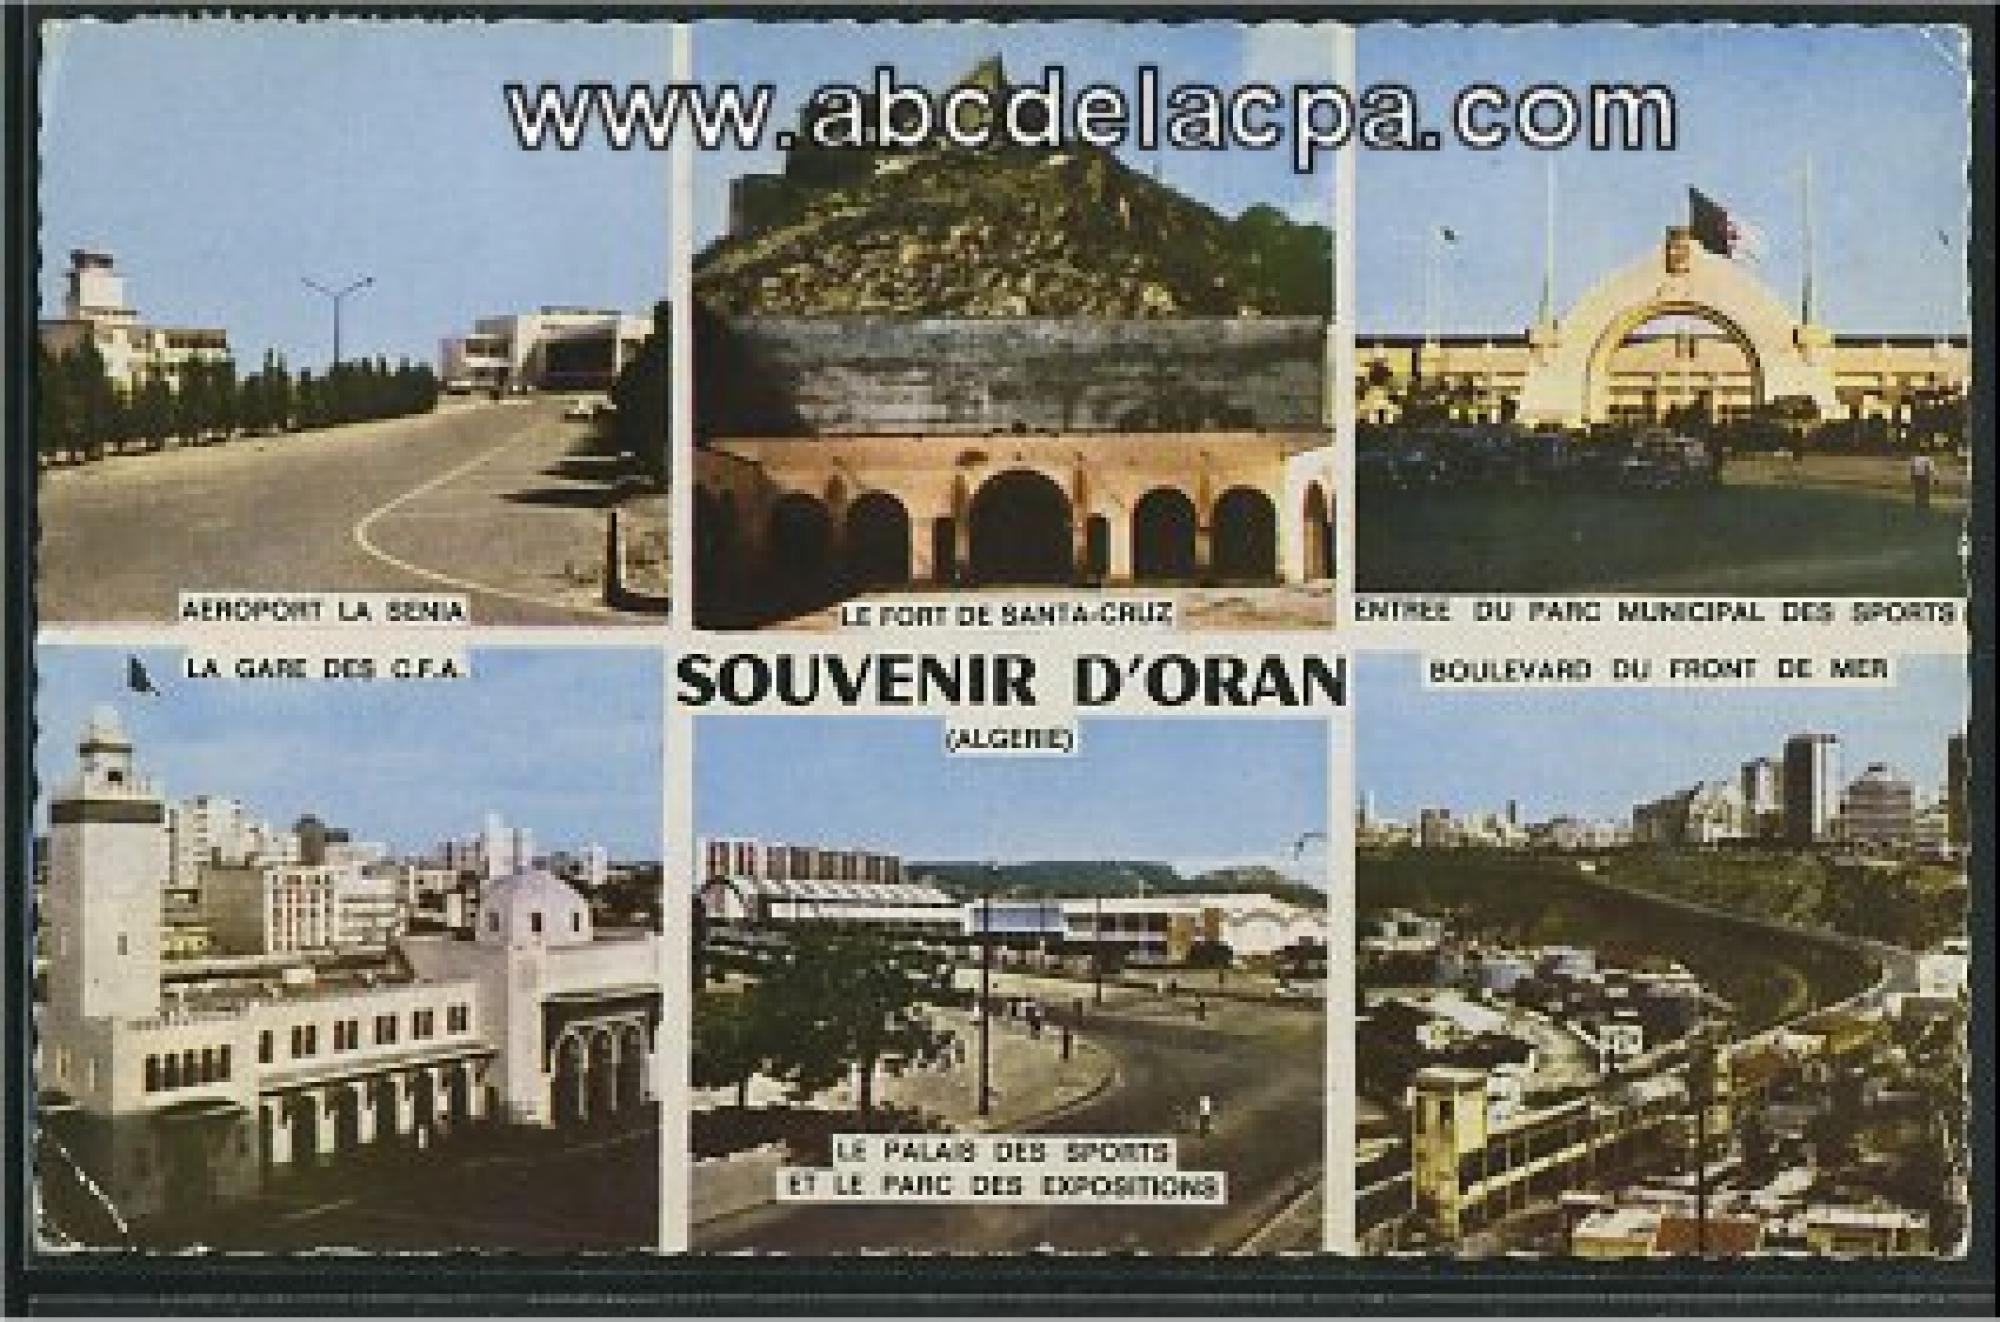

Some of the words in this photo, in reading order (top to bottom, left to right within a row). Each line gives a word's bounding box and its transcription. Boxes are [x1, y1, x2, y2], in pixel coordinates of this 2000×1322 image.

[338, 600, 373, 622] LA
[841, 602, 872, 627] LE
[879, 604, 948, 627] FORT
[956, 602, 994, 627] DE
[1001, 602, 1173, 627] SANTA-CRUZ
[1473, 600, 1513, 622] DU
[1528, 600, 1601, 622] PARC
[1618, 600, 1766, 622] MUNICIPAL
[1782, 600, 1836, 622] DES
[1852, 600, 1956, 624] SPORTS
[187, 658, 222, 679] LA
[235, 658, 307, 679] GARE
[324, 658, 376, 679] DES
[676, 653, 1037, 707] SOUVENIR
[1076, 653, 1347, 707] D'ORAN
[1429, 658, 1592, 683] BOULEVARD
[1613, 658, 1652, 683] DU
[1670, 658, 1757, 679] FRONT
[1777, 658, 1813, 679] DE
[1830, 658, 1888, 679] MER
[837, 1141, 867, 1163] LE
[884, 1141, 976, 1163] PALAIS
[997, 1141, 1047, 1163] DES
[1066, 1141, 1169, 1163] SPORTS
[788, 1174, 817, 1197] ET
[836, 1174, 863, 1197] LE
[884, 1174, 954, 1197] PARC
[972, 1174, 1023, 1197] DES
[1043, 1174, 1219, 1200] EXPOSITIONS
